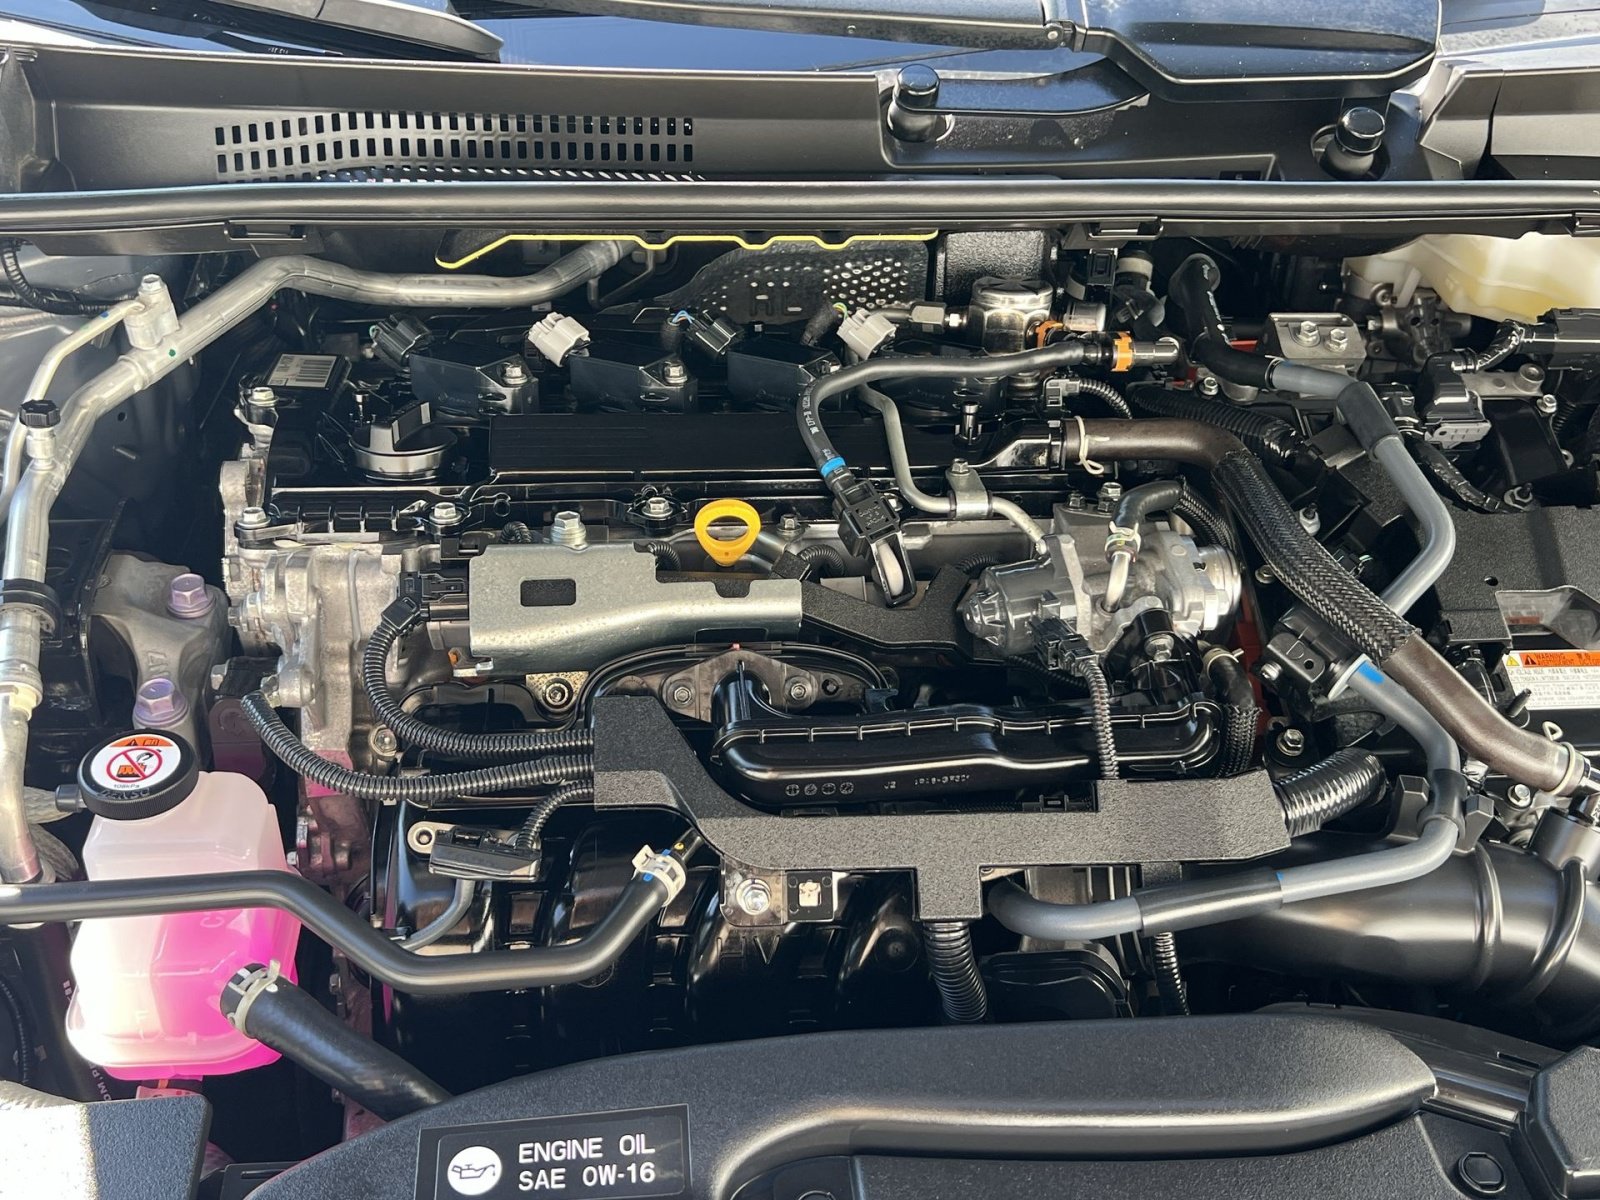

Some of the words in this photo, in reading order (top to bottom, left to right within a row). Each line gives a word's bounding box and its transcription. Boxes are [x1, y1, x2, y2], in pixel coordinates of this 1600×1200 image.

[518, 1137, 604, 1163] ENGINE
[619, 1134, 655, 1155] OIL
[518, 1168, 566, 1191] SAE
[582, 1162, 656, 1186] 0W-16
